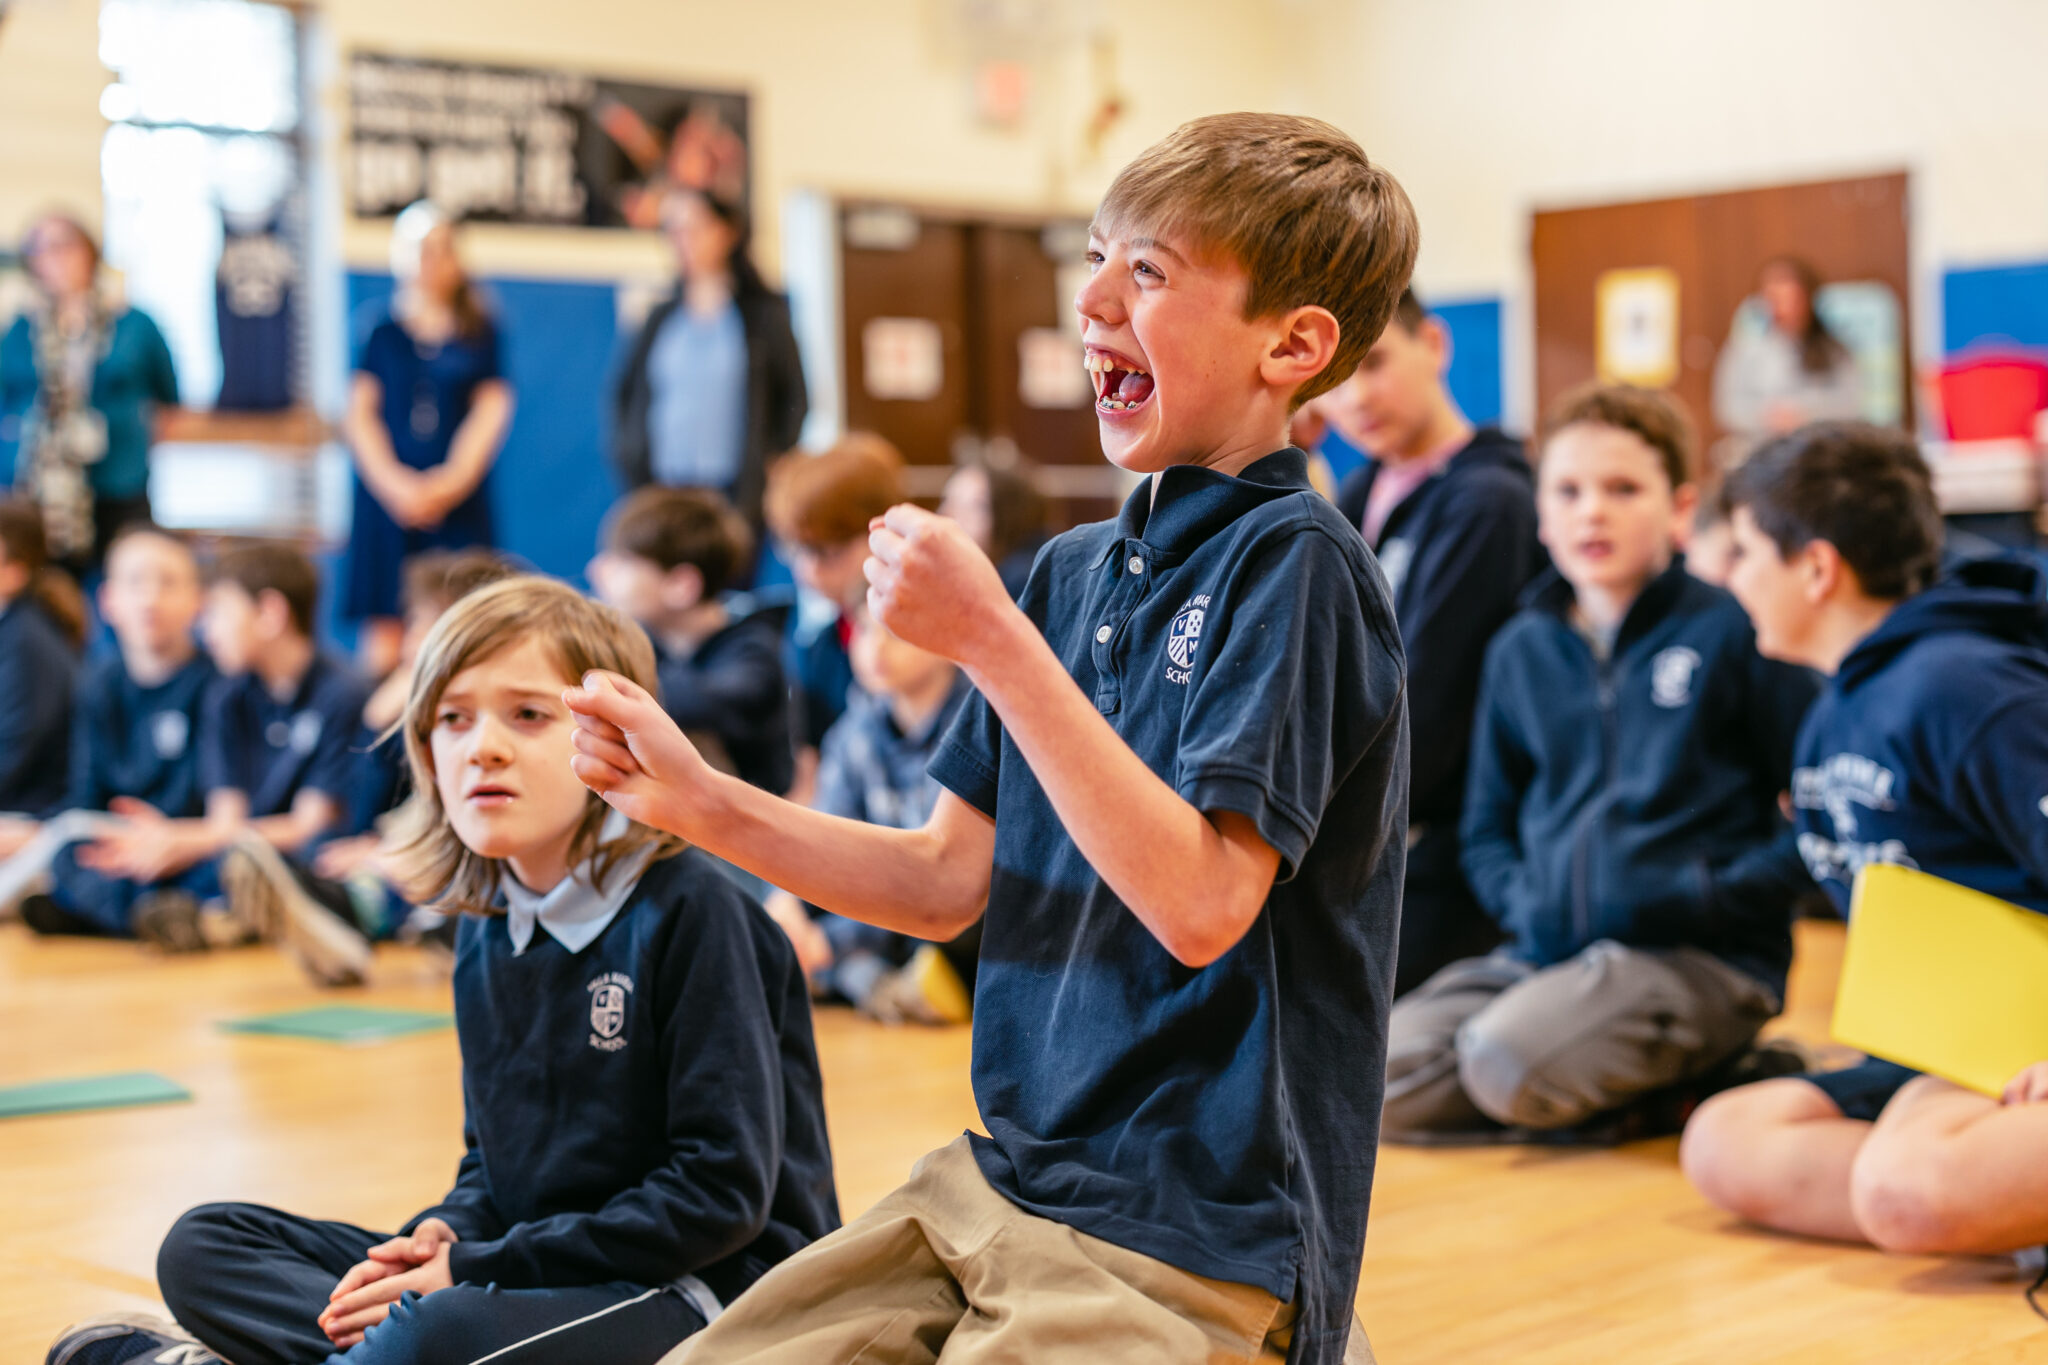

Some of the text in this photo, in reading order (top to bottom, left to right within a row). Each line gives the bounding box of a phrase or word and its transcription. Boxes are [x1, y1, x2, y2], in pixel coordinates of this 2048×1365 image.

[1192, 594, 1211, 609] MAR
[1178, 619, 1187, 632] V
[1165, 666, 1192, 685] SCHO
